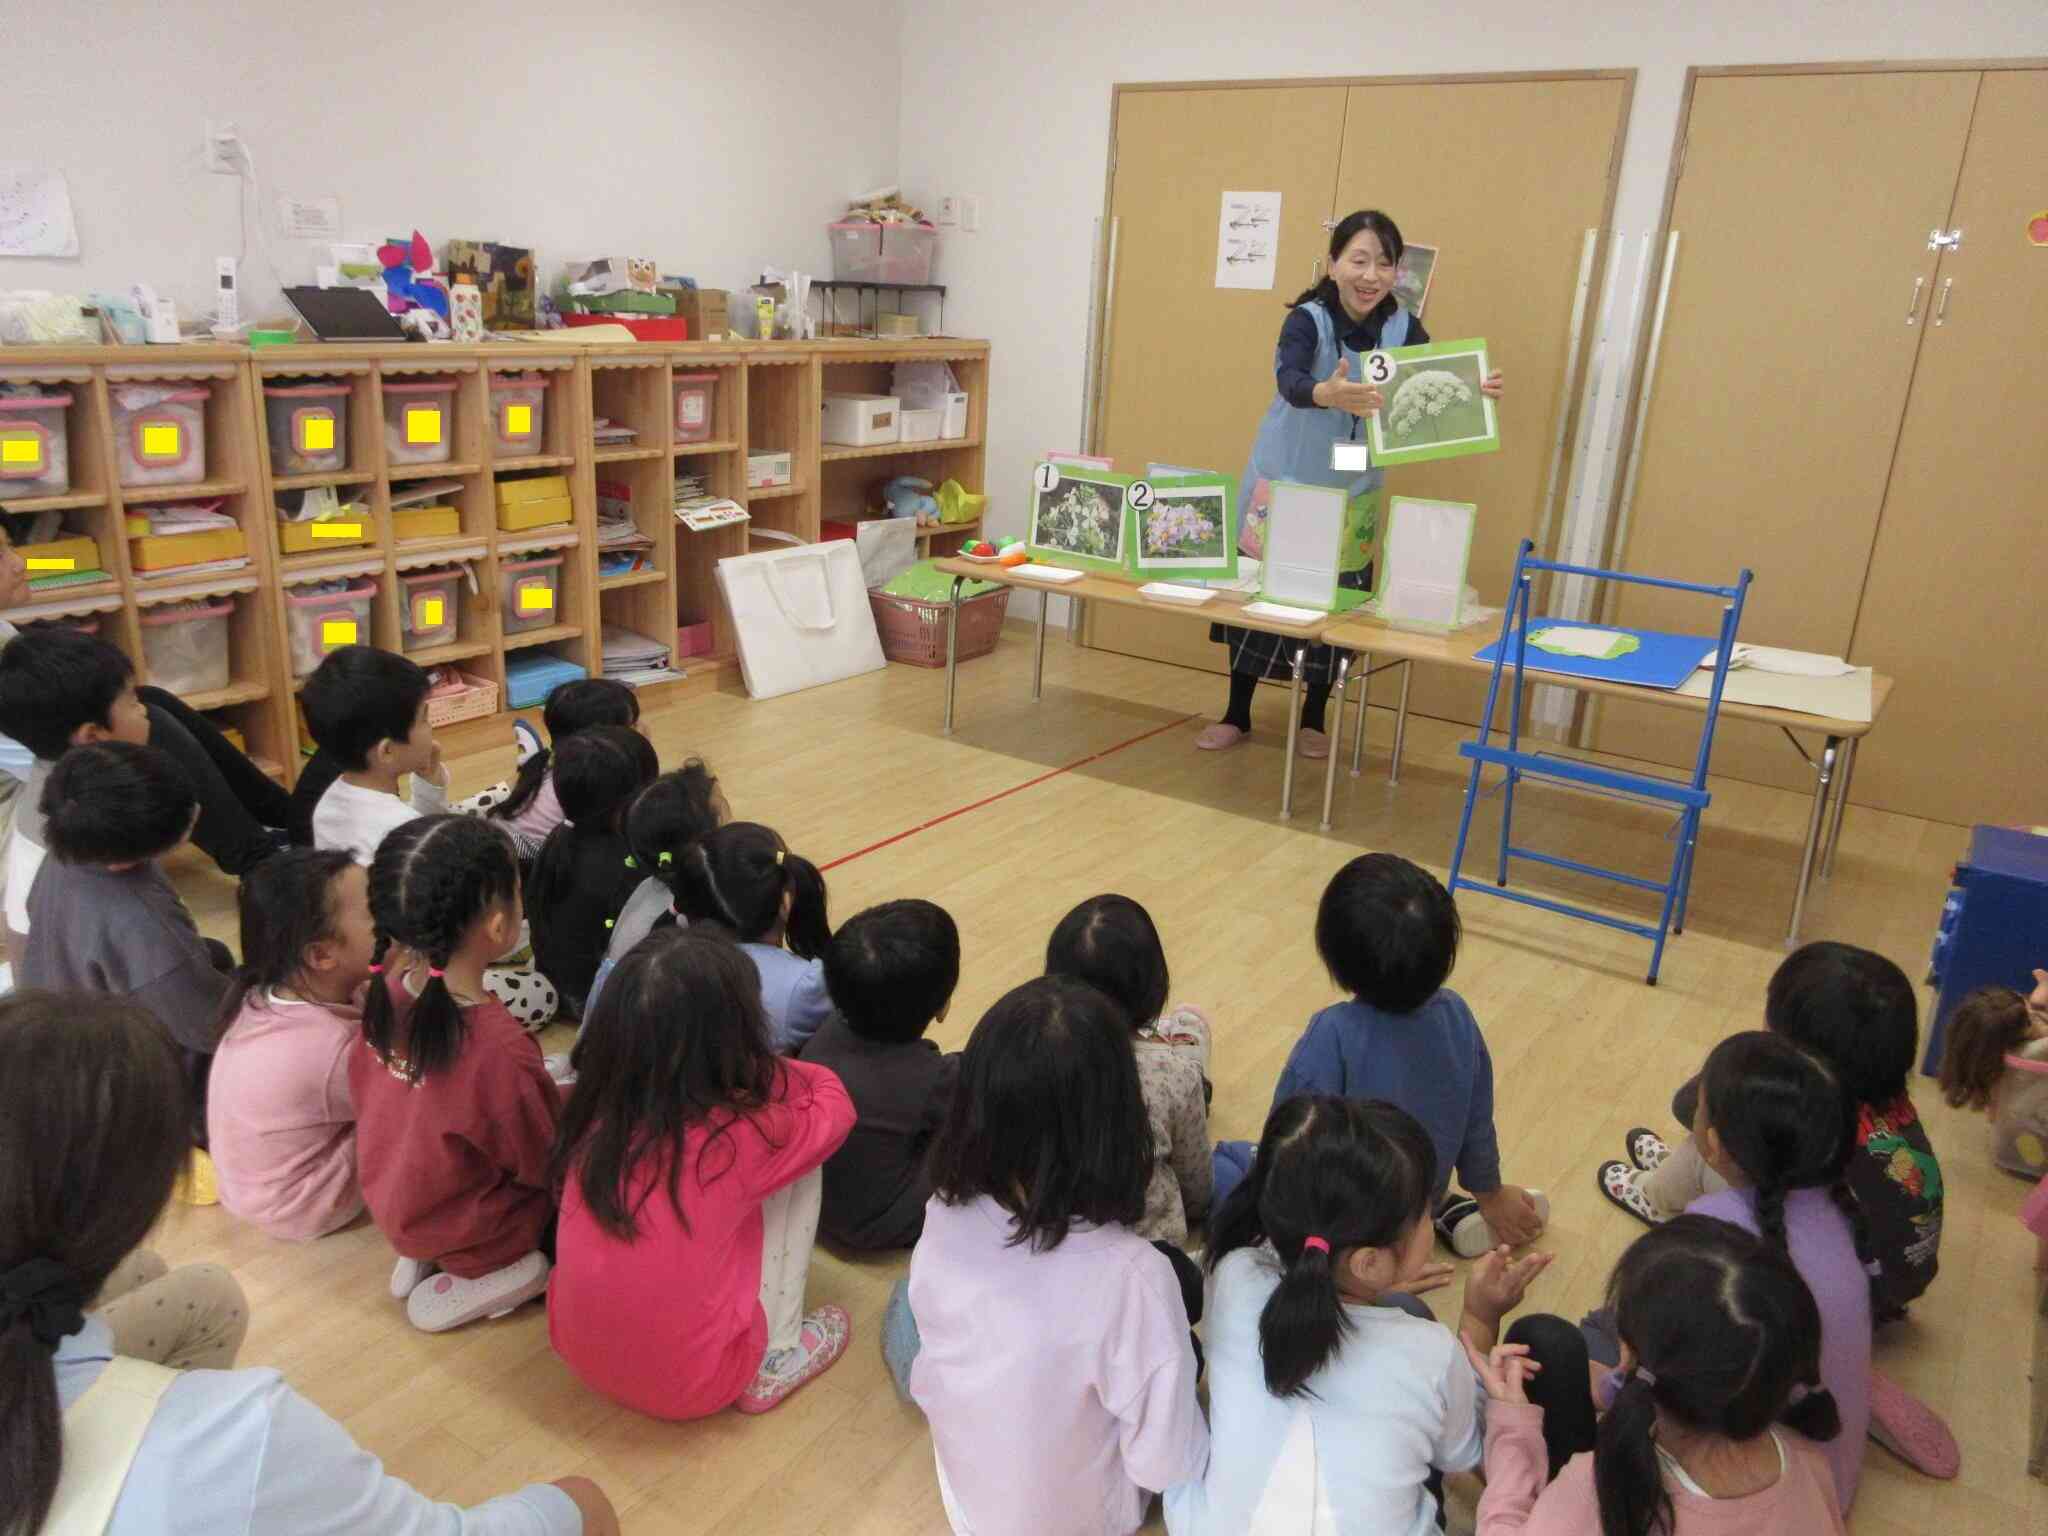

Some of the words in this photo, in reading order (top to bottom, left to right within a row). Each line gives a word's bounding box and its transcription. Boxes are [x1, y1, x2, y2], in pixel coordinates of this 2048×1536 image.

[1370, 354, 1388, 382] 3
[1041, 465, 1050, 488] 1
[1134, 484, 1149, 507] 2
